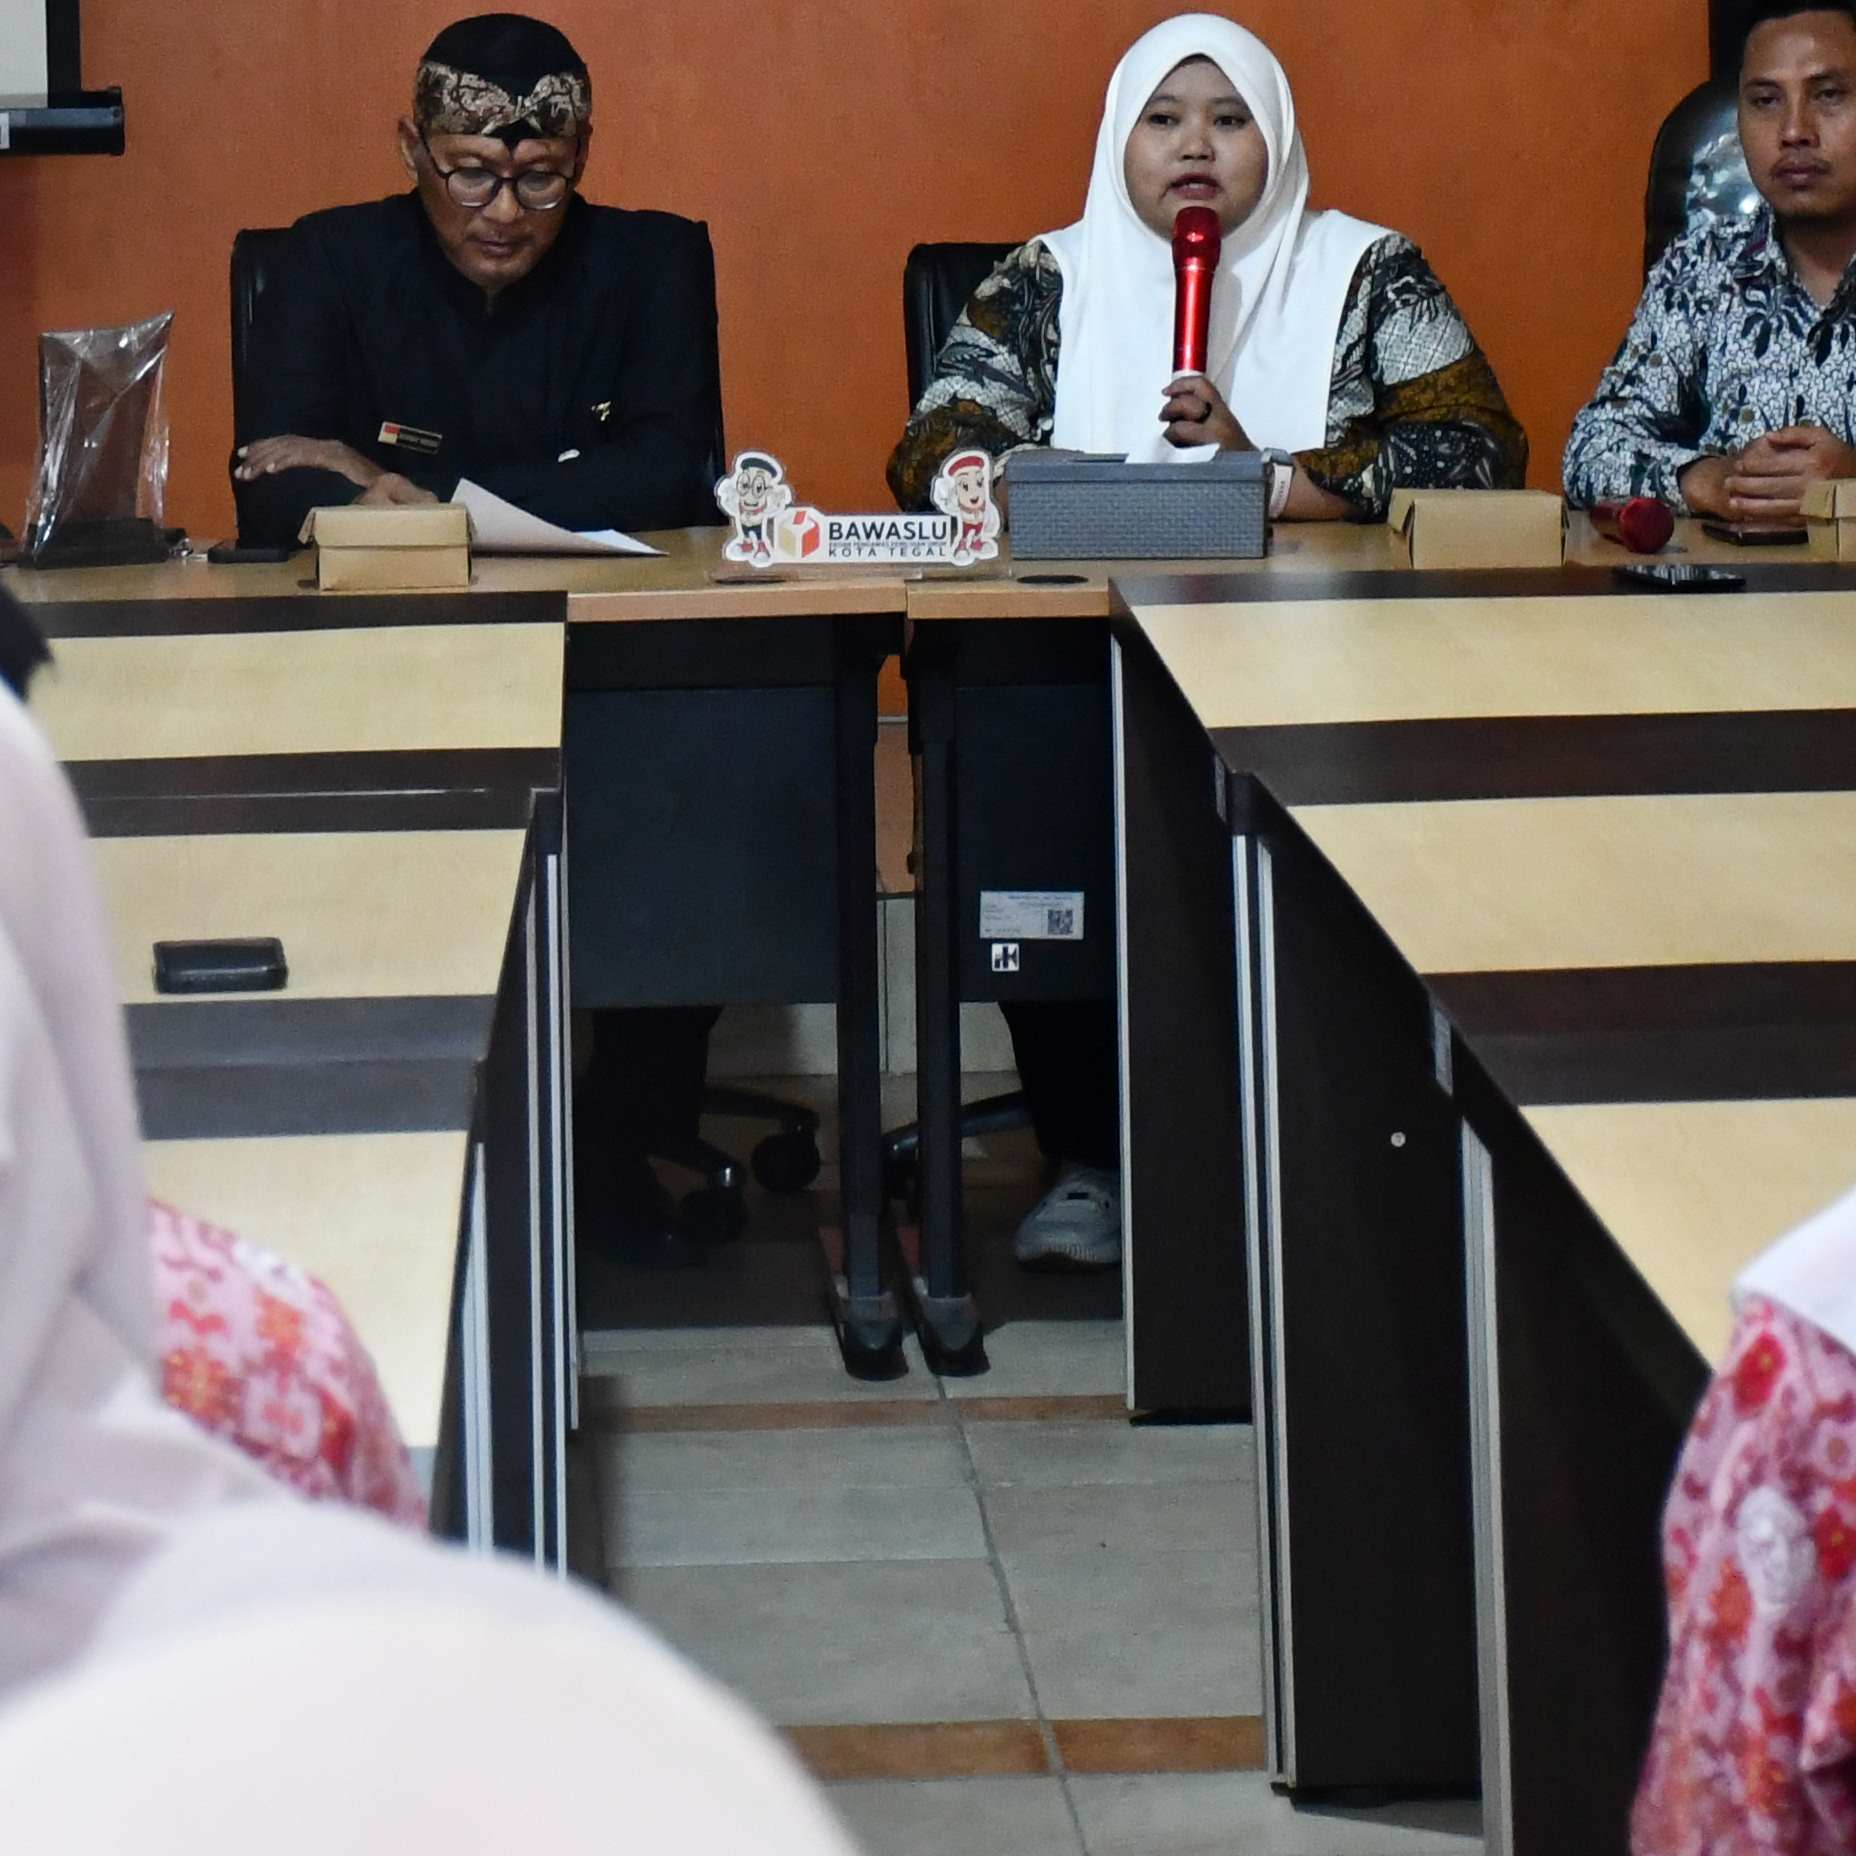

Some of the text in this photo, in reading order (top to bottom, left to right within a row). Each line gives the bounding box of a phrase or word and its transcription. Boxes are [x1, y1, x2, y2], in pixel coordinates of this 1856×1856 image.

[828, 521, 947, 540] BAWASLU
[828, 546, 947, 557] KOTA TEGAL
